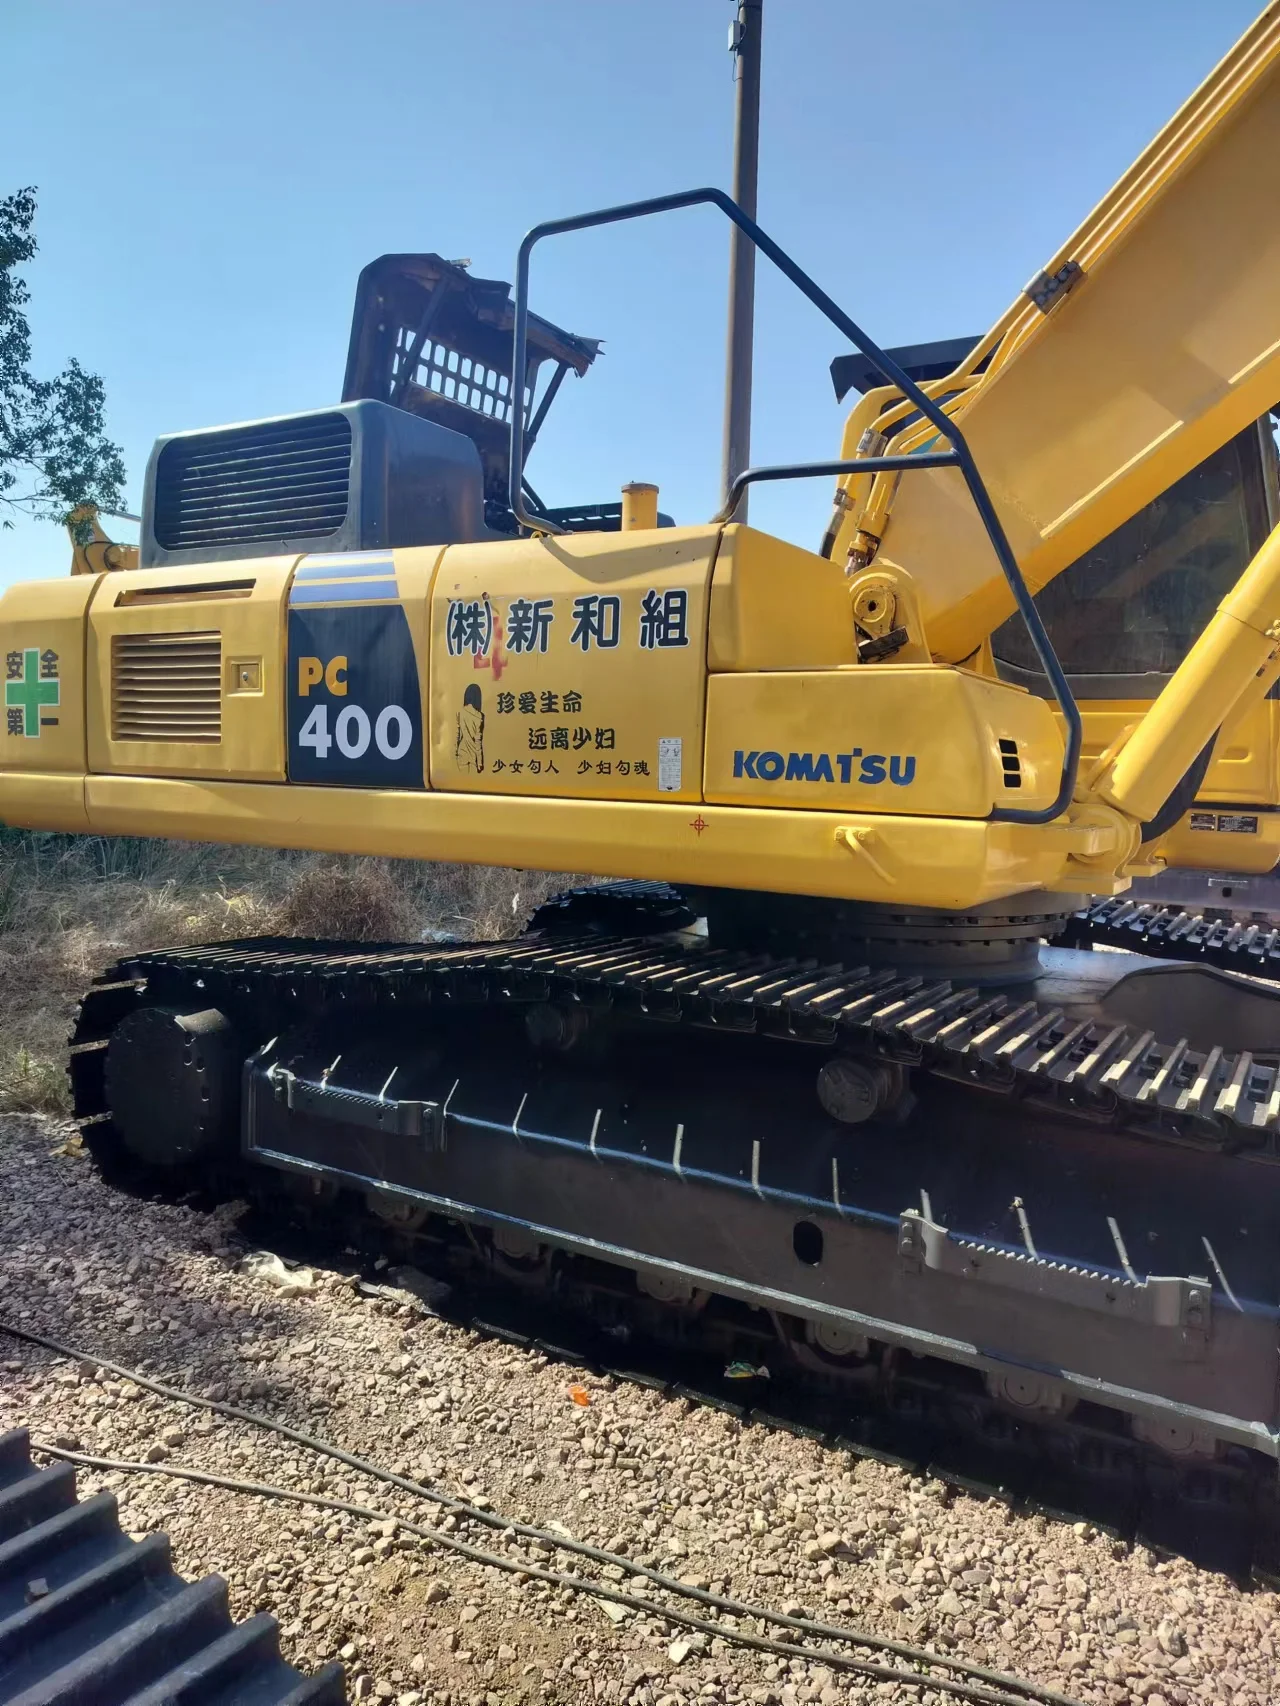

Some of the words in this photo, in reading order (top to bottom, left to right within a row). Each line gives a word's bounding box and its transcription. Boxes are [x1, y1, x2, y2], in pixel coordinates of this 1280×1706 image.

[447, 588, 690, 656] (株)新和組
[6, 649, 59, 679] 安全
[299, 655, 348, 697] PC
[497, 690, 582, 714] 珍爱生命
[7, 708, 59, 736] 第一
[299, 704, 413, 761] 400
[528, 726, 615, 750] 远离少妇
[492, 759, 560, 774] 少女勾人
[577, 759, 651, 776] 少妇勾魂
[733, 748, 916, 786] KOMATSU
